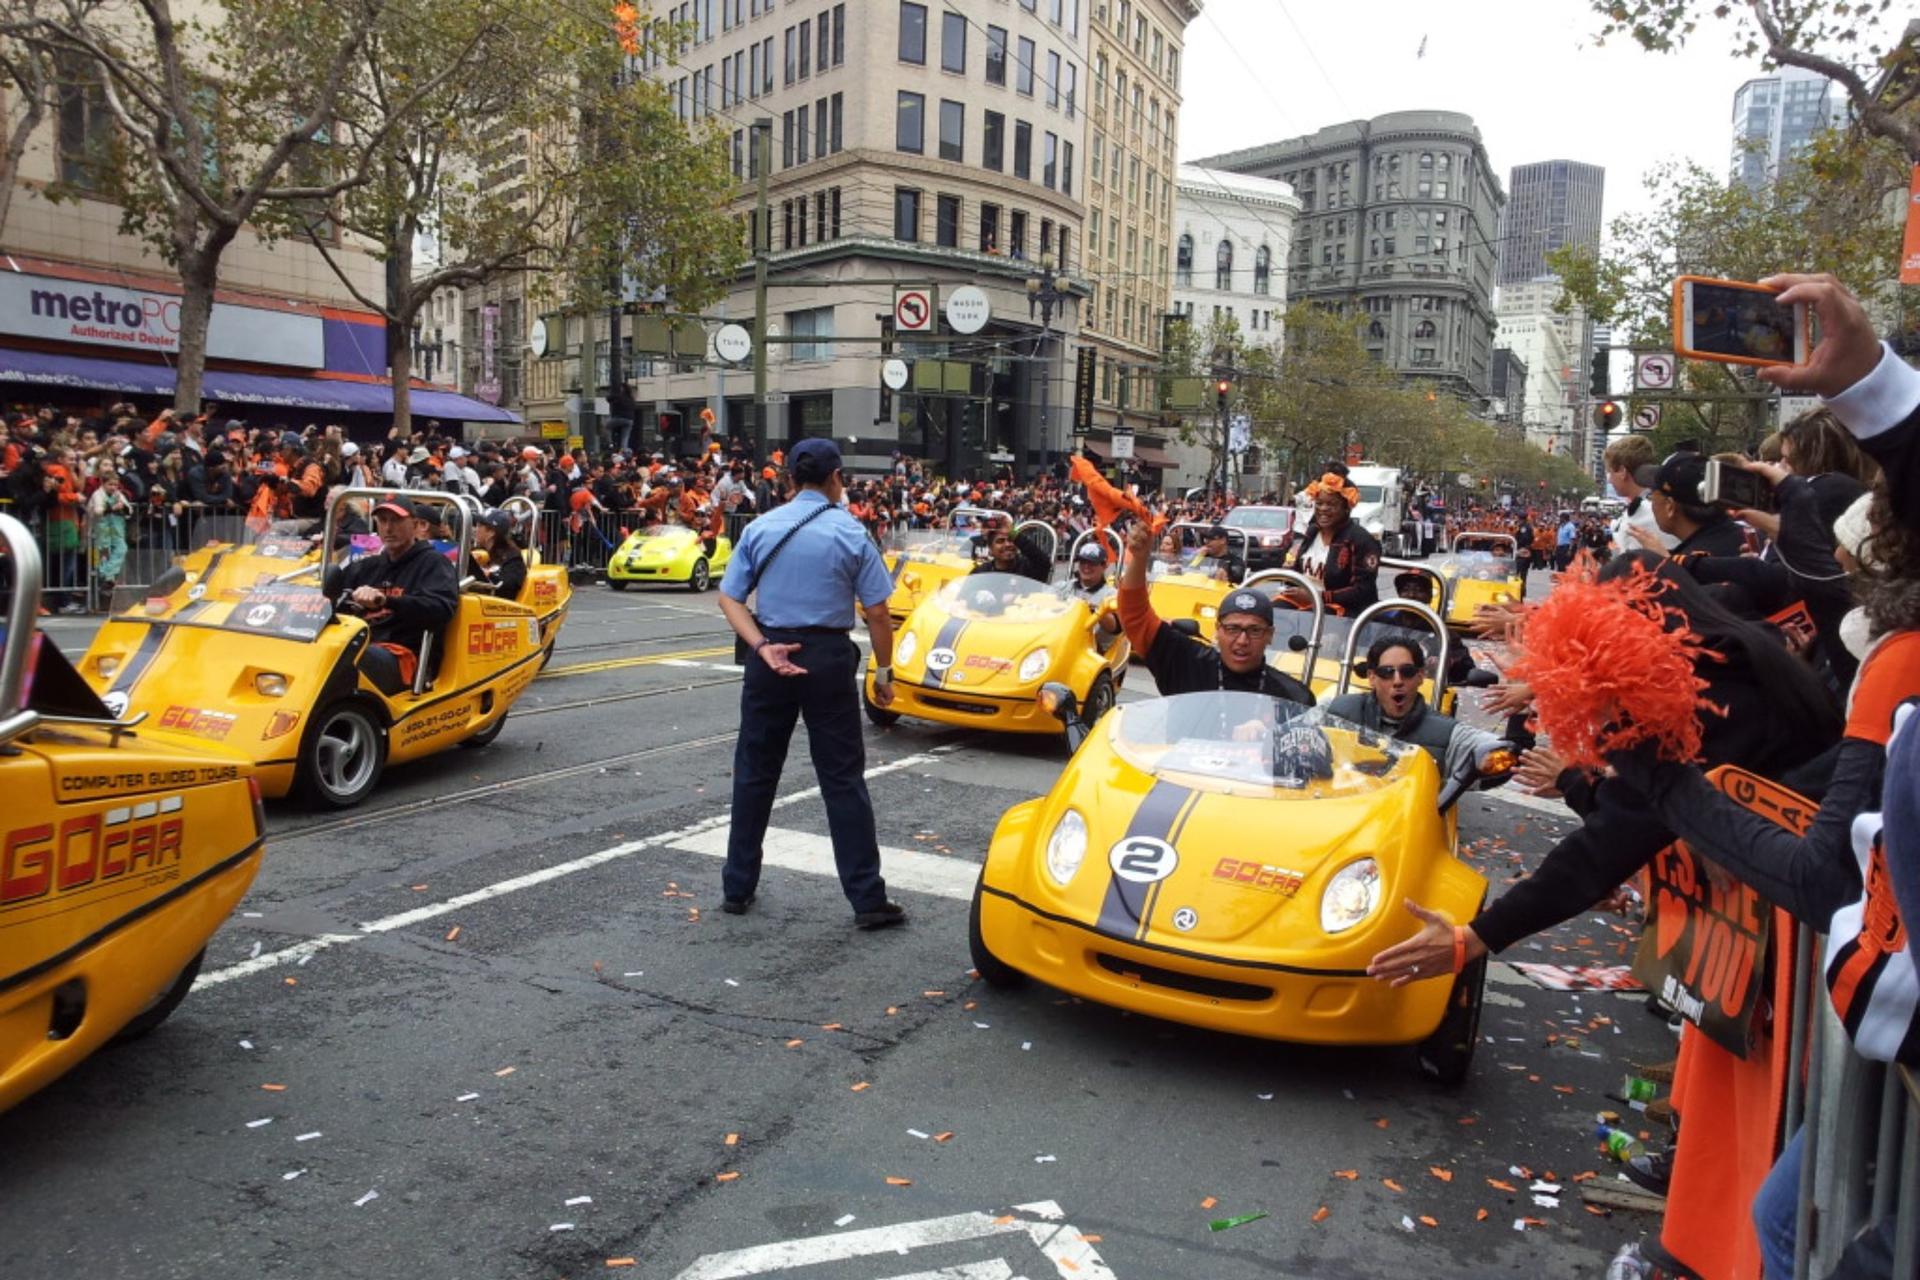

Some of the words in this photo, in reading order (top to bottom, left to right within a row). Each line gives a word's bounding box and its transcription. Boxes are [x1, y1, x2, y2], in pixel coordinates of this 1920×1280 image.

[31, 289, 182, 334] metroPC
[71, 324, 134, 341] Authorized
[138, 332, 176, 346] Dealer
[468, 622, 518, 655] GOCAR
[932, 653, 953, 665] 10
[160, 704, 233, 736] GOCAR
[61, 773, 145, 791] COMPUTER
[148, 769, 197, 786] GUIDED
[199, 766, 239, 780] TOURS
[0, 814, 185, 905] GOCAR
[1119, 841, 1165, 876] 2
[1212, 857, 1303, 897] GOCAR
[1684, 906, 1758, 1019] YOU
